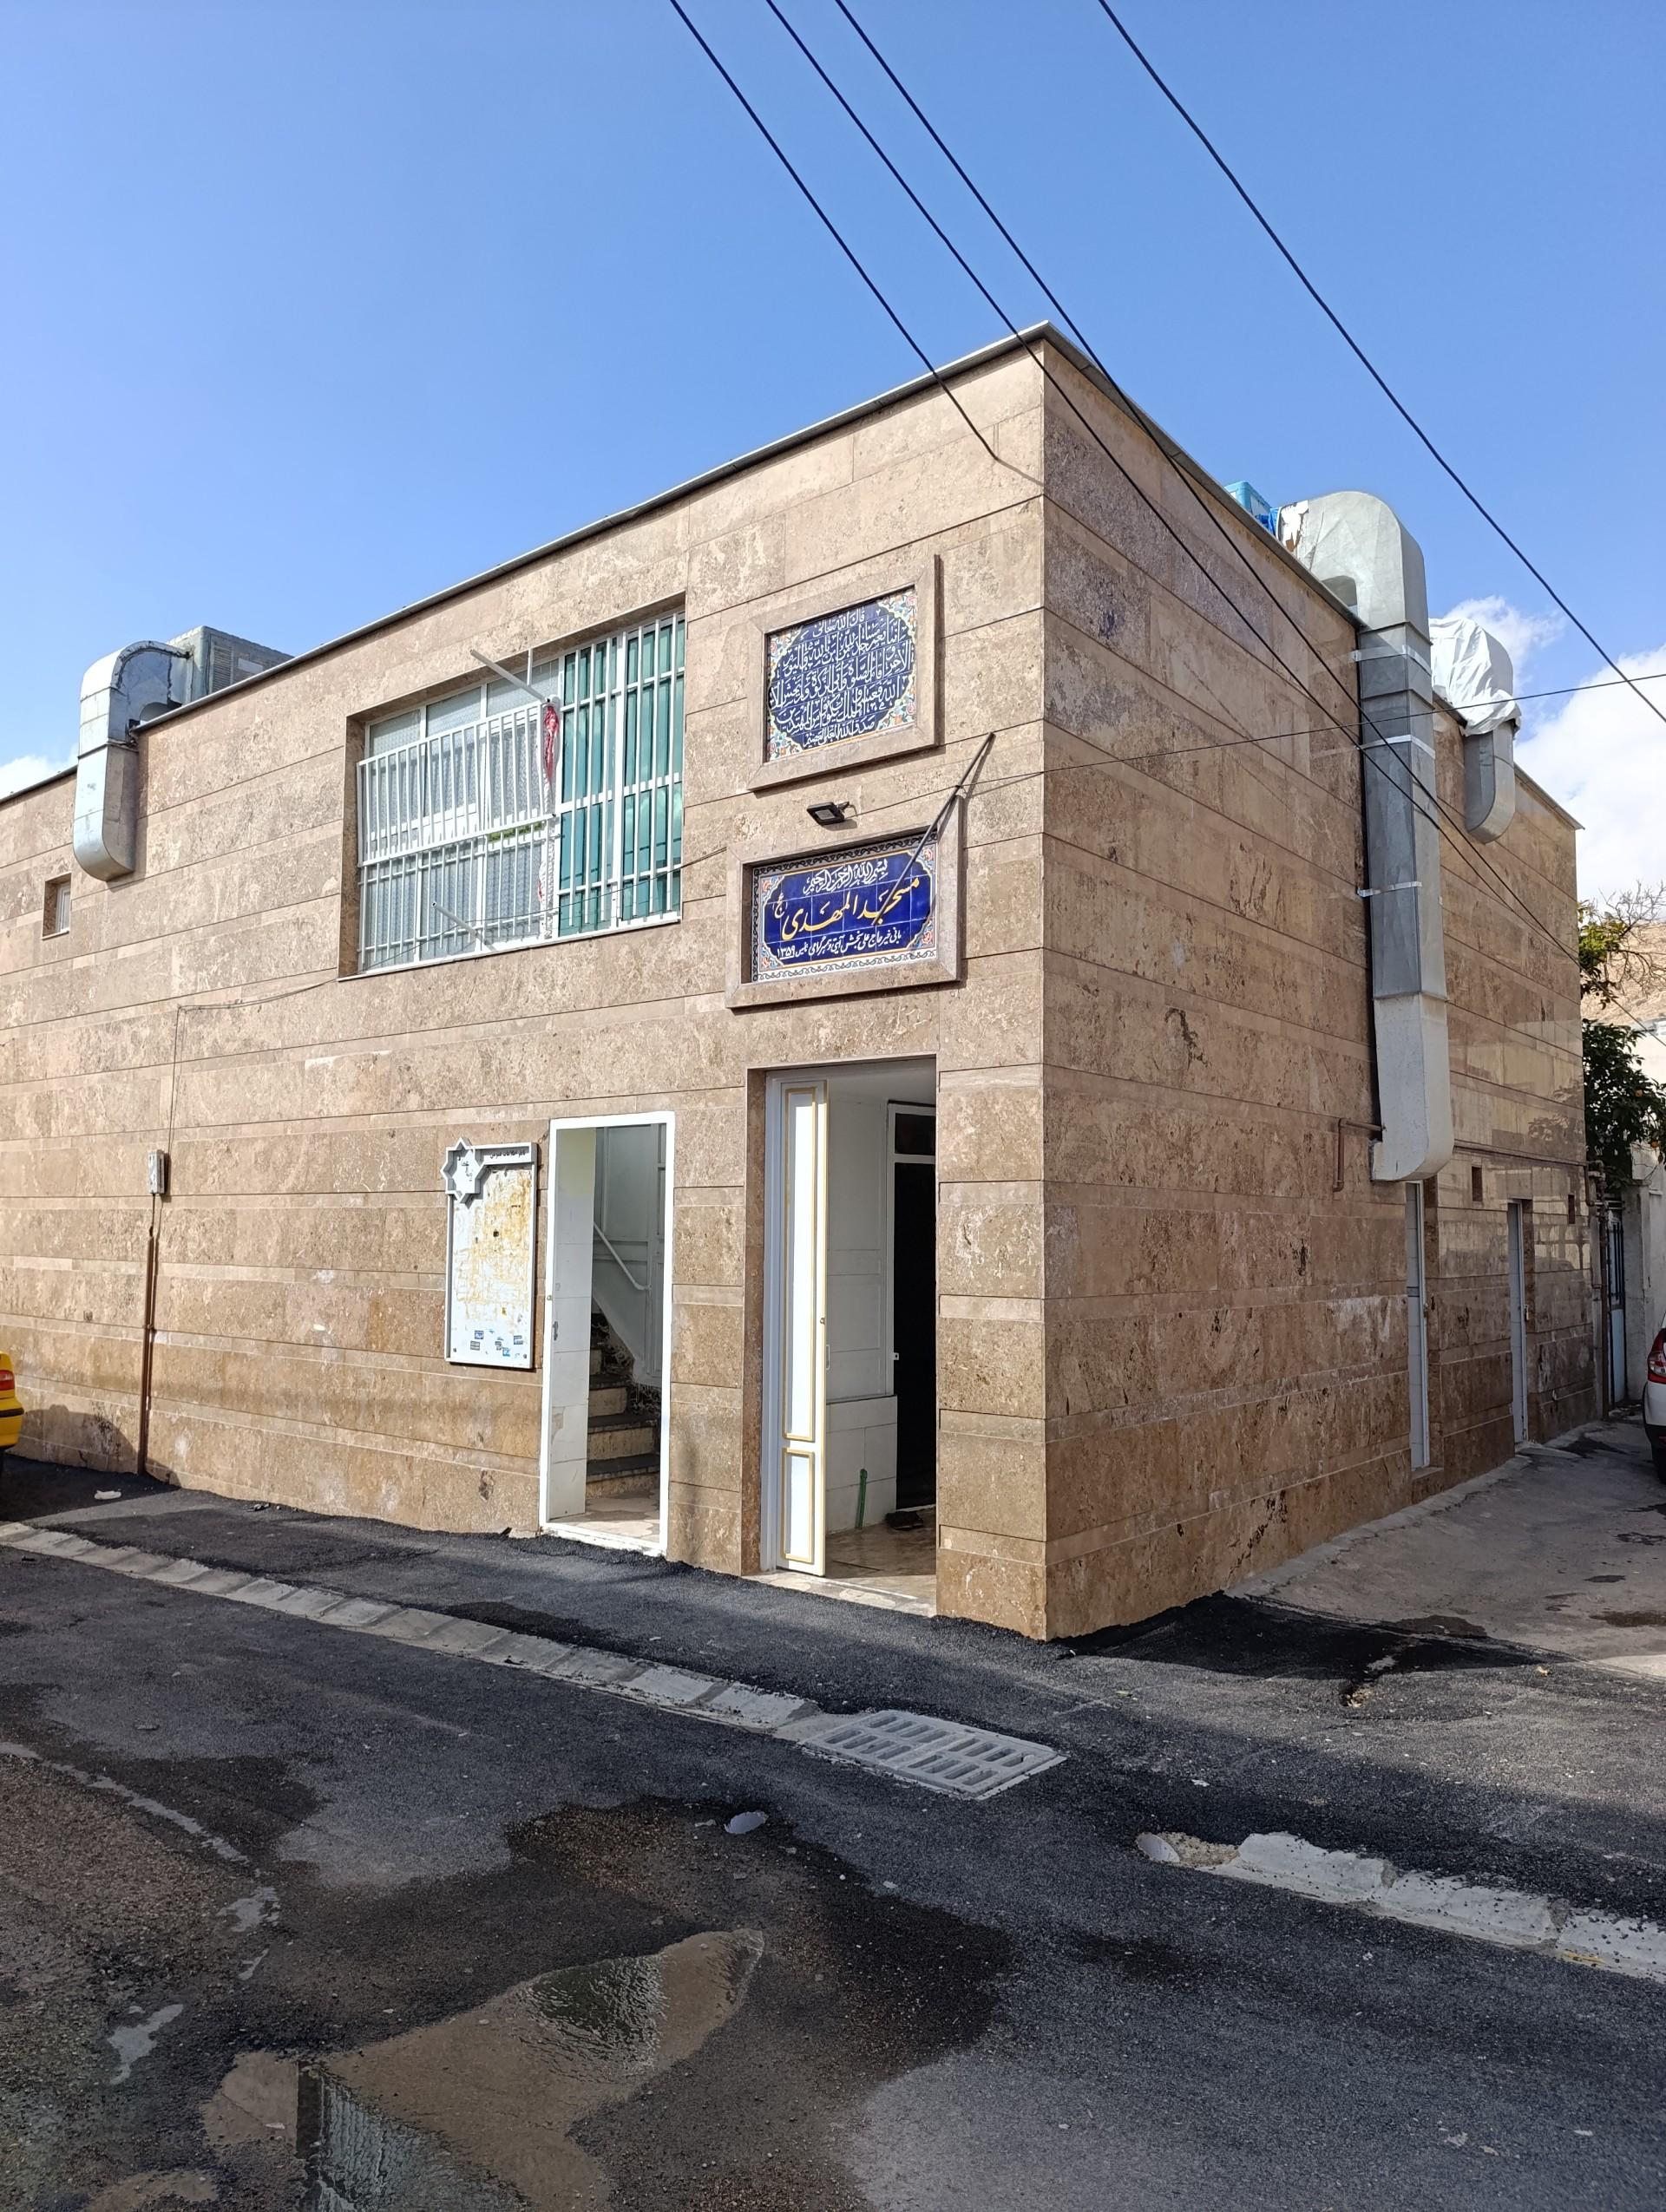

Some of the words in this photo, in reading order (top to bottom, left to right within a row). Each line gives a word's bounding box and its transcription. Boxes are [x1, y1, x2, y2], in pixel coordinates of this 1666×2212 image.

[782, 892, 856, 939] المهدی
[857, 878, 919, 924] مسجد
[856, 933, 869, 950] علی
[867, 931, 881, 946] حاج
